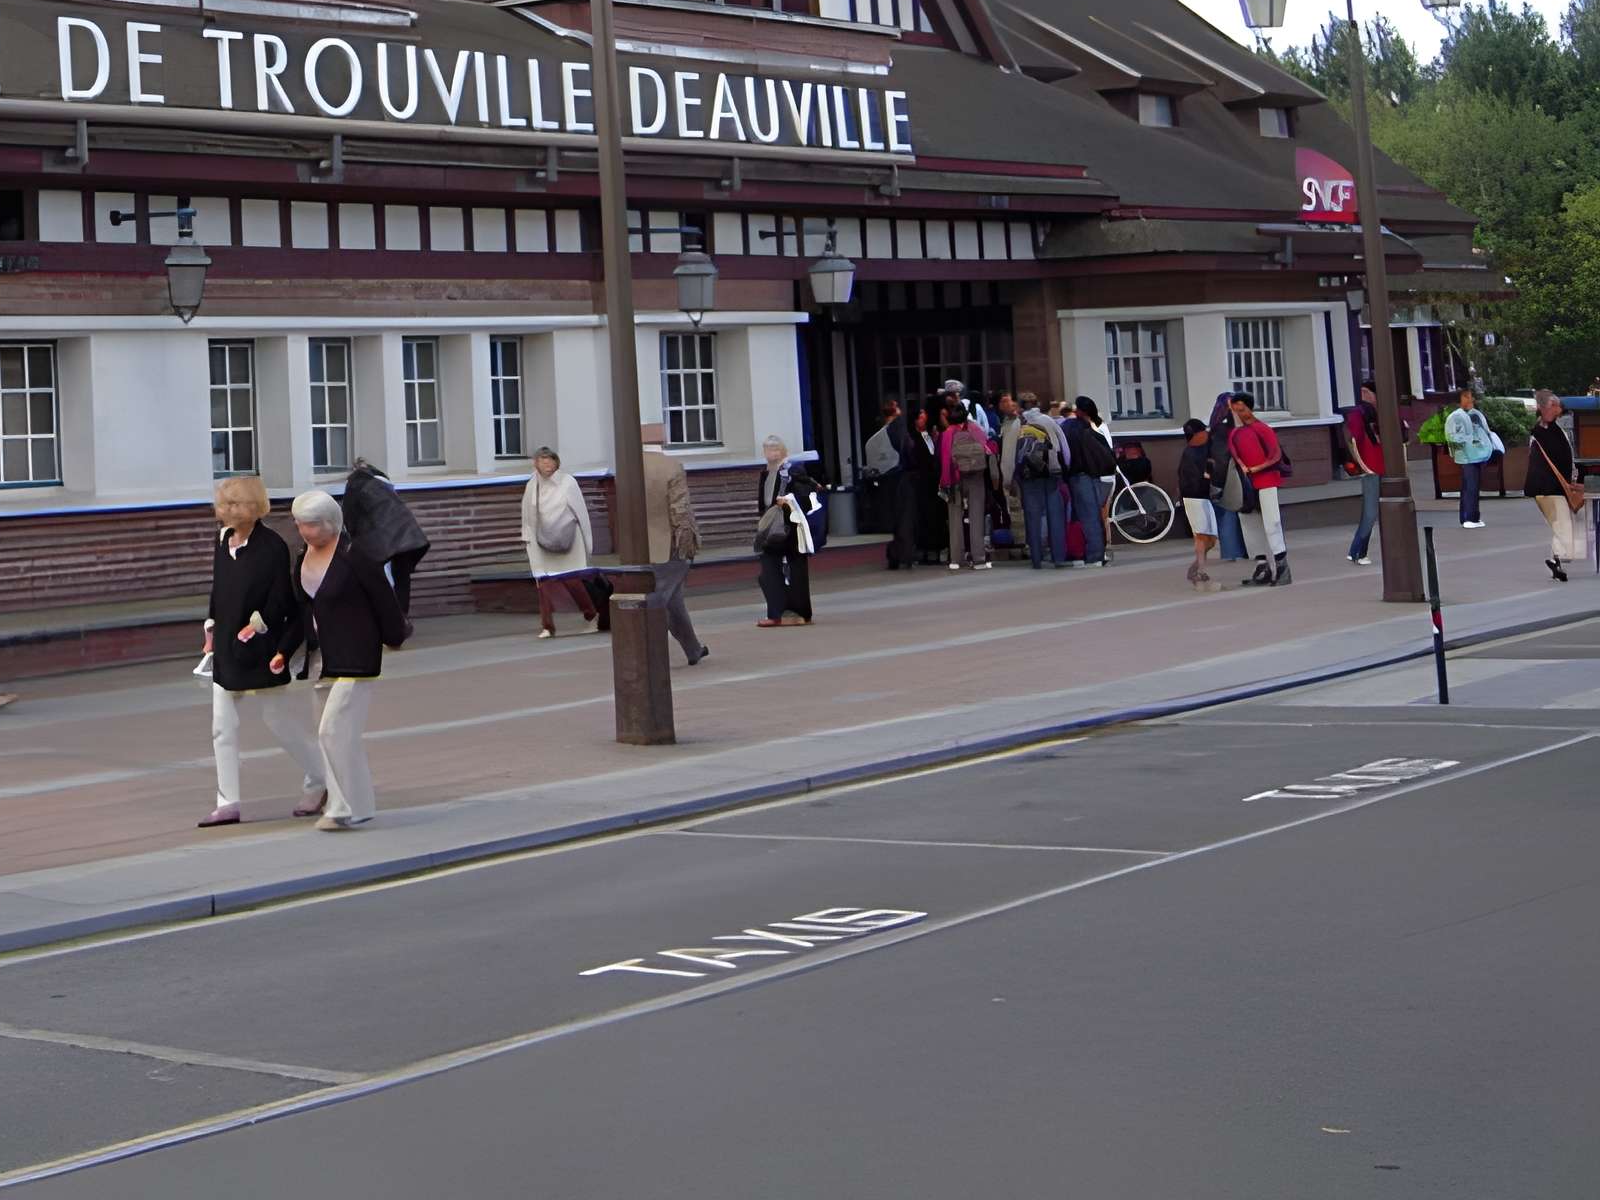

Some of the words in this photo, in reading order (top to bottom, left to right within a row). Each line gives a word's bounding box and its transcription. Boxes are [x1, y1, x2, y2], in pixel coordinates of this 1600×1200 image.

[57, 16, 166, 104] DE
[202, 28, 595, 132] TROUVILLE
[628, 66, 912, 153] DEAUVILLE
[578, 907, 929, 977] TAXIS
